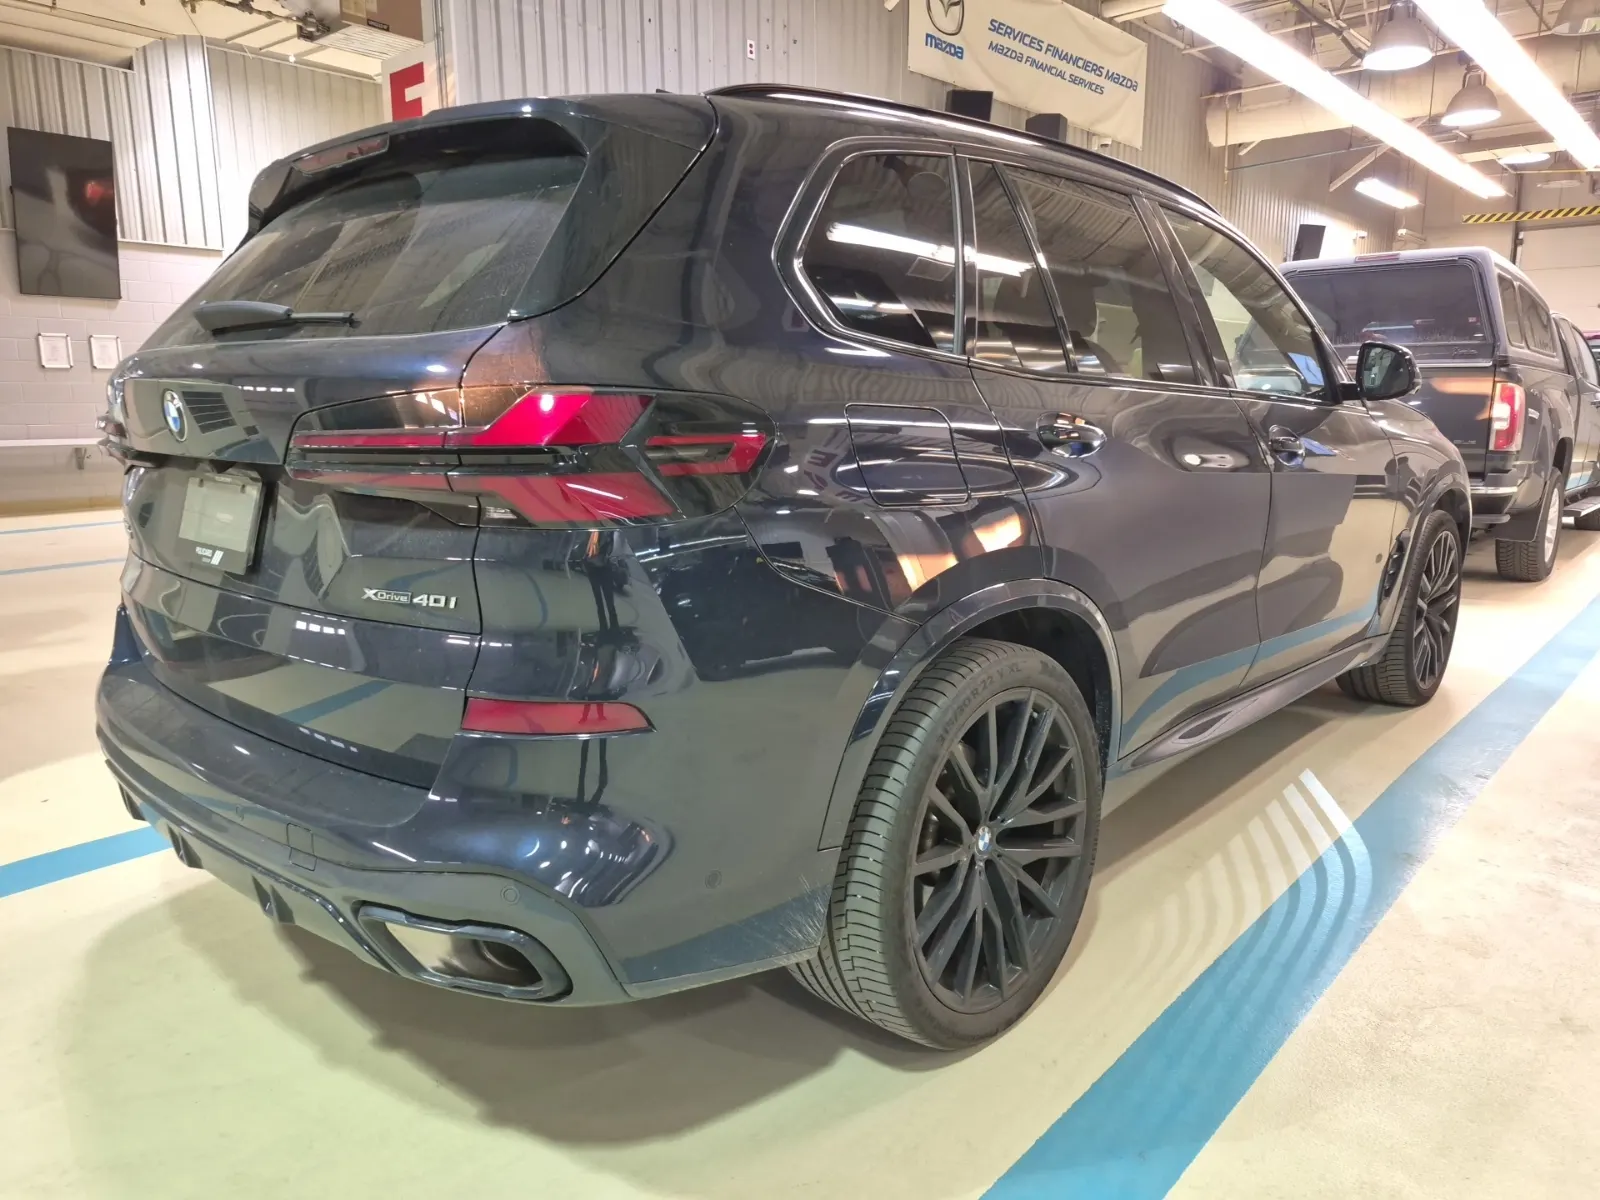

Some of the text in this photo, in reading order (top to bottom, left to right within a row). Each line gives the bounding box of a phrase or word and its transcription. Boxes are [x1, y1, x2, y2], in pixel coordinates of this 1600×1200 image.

[988, 18, 1045, 52] SERVICES
[1045, 43, 1105, 78] FINANCIERS
[1024, 56, 1067, 81] FINANCIAL
[1068, 73, 1105, 95] SERVICES
